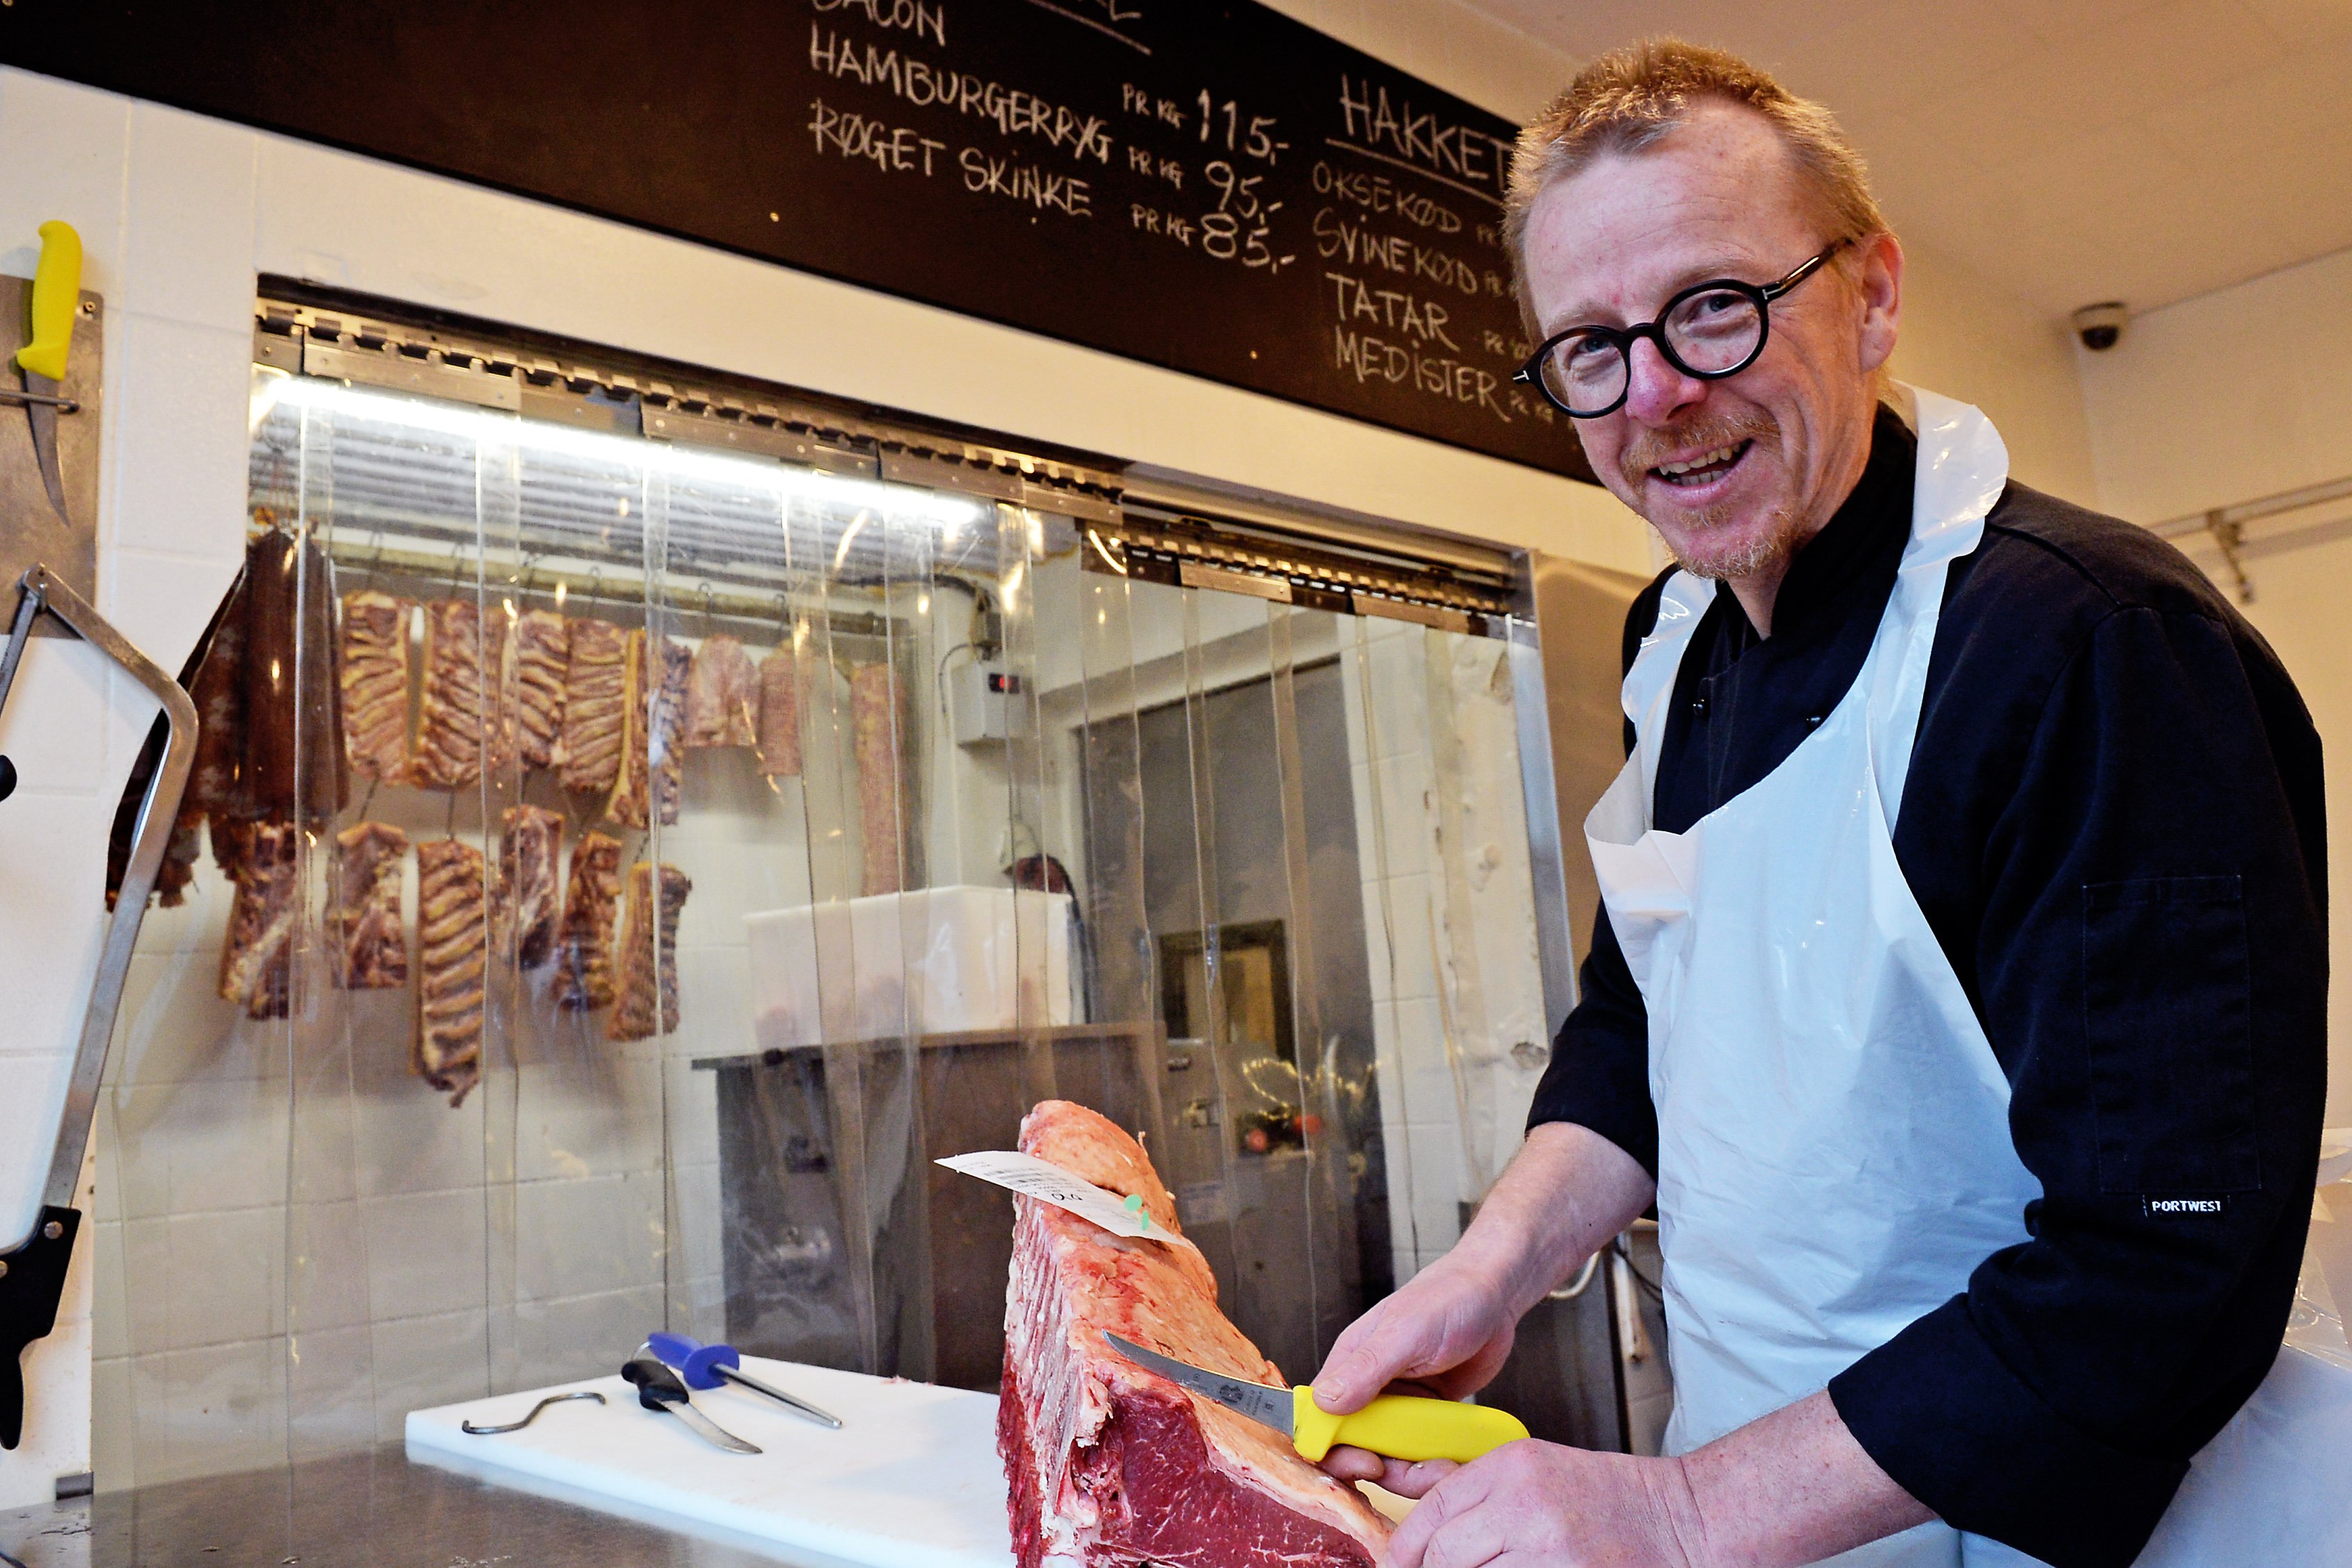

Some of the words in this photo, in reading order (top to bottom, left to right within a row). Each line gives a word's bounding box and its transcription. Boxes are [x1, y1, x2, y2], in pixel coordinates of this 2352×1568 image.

[810, 19, 1113, 164] HAMBURGERRYG
[1122, 82, 1150, 117] PR
[1339, 73, 1513, 191] HAKKET
[808, 98, 946, 178] RØGET
[1130, 203, 1161, 235] PR
[1324, 271, 1461, 352] TATAR
